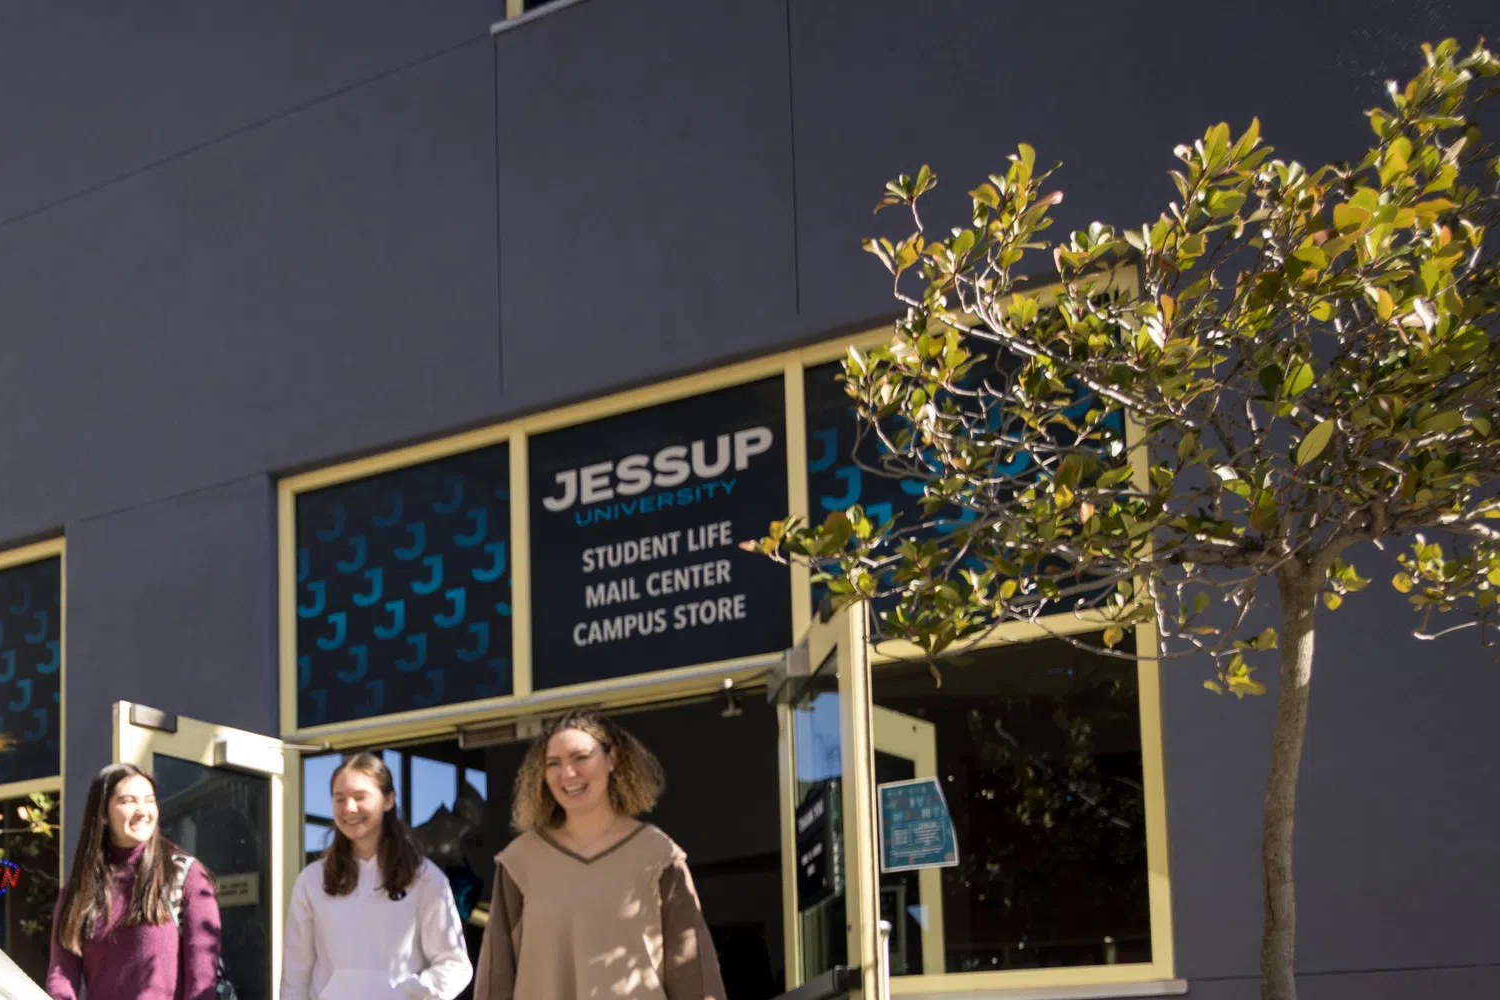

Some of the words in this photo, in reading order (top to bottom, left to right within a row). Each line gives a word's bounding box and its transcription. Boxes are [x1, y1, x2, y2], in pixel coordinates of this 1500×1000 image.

[542, 427, 774, 512] JESSUP
[575, 478, 737, 527] UNIVERSITY
[582, 531, 682, 573] STUDENT
[688, 521, 732, 552] LIFE
[585, 576, 640, 608] MAIL
[646, 559, 731, 597] CENTER
[573, 608, 667, 647] CAMPUS
[673, 594, 746, 630] STORE
